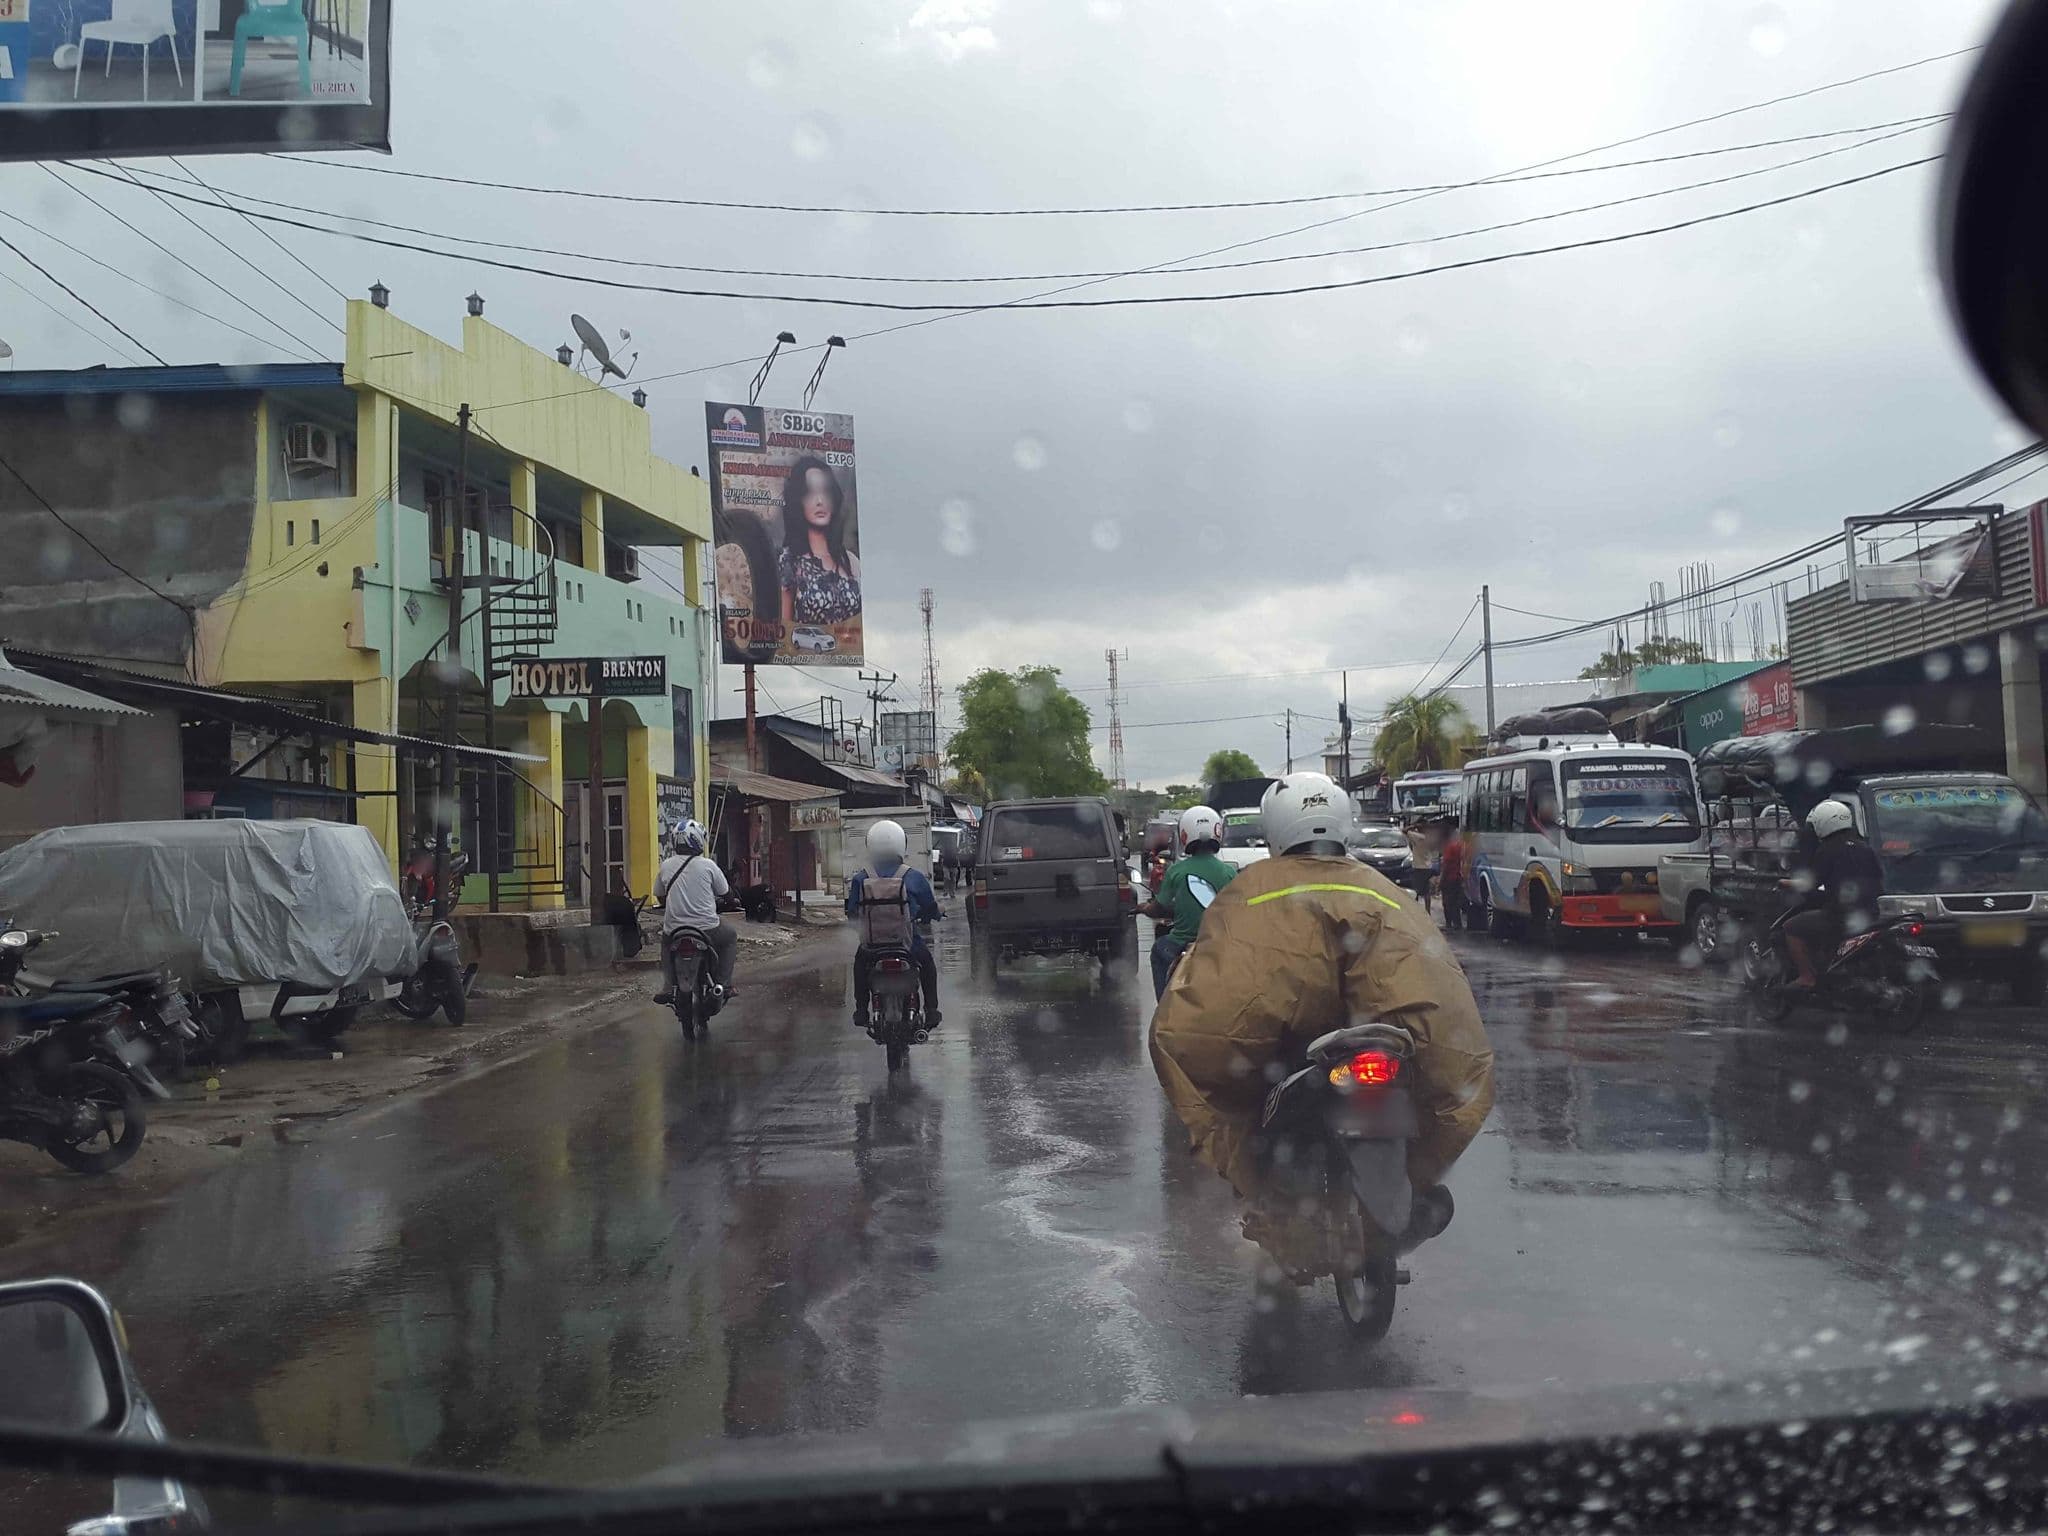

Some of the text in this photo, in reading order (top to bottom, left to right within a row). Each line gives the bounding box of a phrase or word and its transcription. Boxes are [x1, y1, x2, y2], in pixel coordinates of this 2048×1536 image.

[782, 415, 824, 433] SBBC
[826, 453, 854, 466] EXPO
[512, 662, 592, 695] HOTEL
[602, 660, 662, 677] BRENTON
[1773, 681, 1789, 706] 1GB
[1700, 708, 1723, 729] oppo
[1622, 764, 1655, 772] KUPANG
